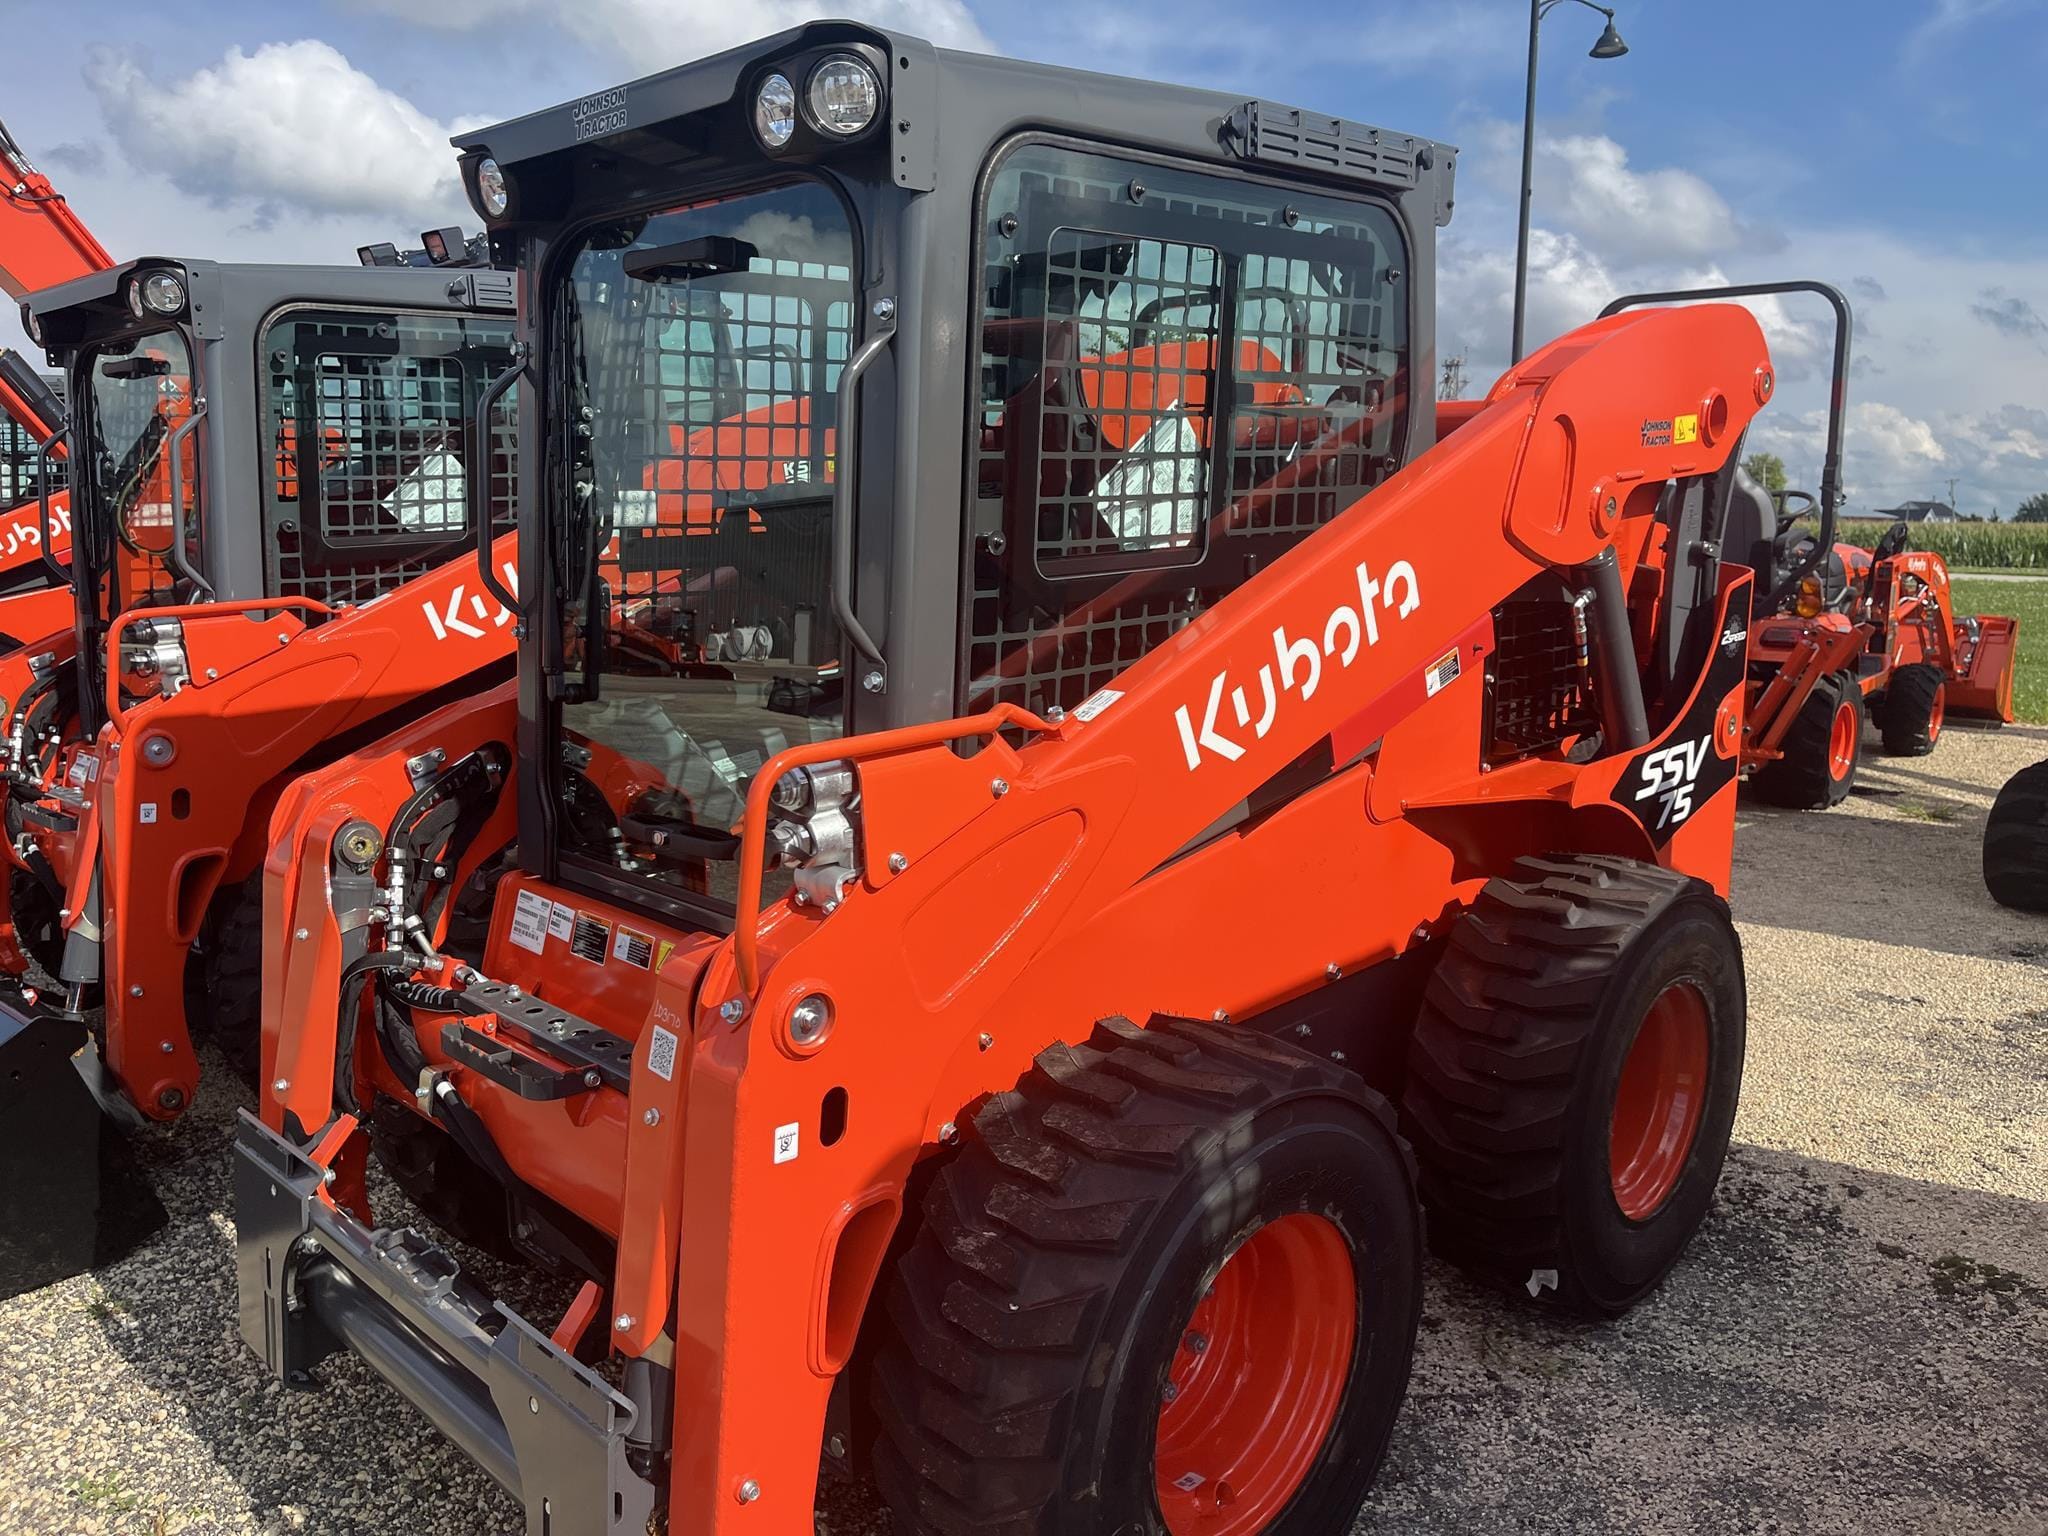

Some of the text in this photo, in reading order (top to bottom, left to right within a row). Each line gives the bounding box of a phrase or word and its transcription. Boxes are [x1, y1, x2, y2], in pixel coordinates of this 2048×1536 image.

[573, 87, 627, 119] JOHNSON
[575, 109, 628, 140] TRACTOR
[1174, 560, 1421, 772] Kubota
[1634, 734, 1712, 801] SSV
[1656, 783, 1695, 830] 75
